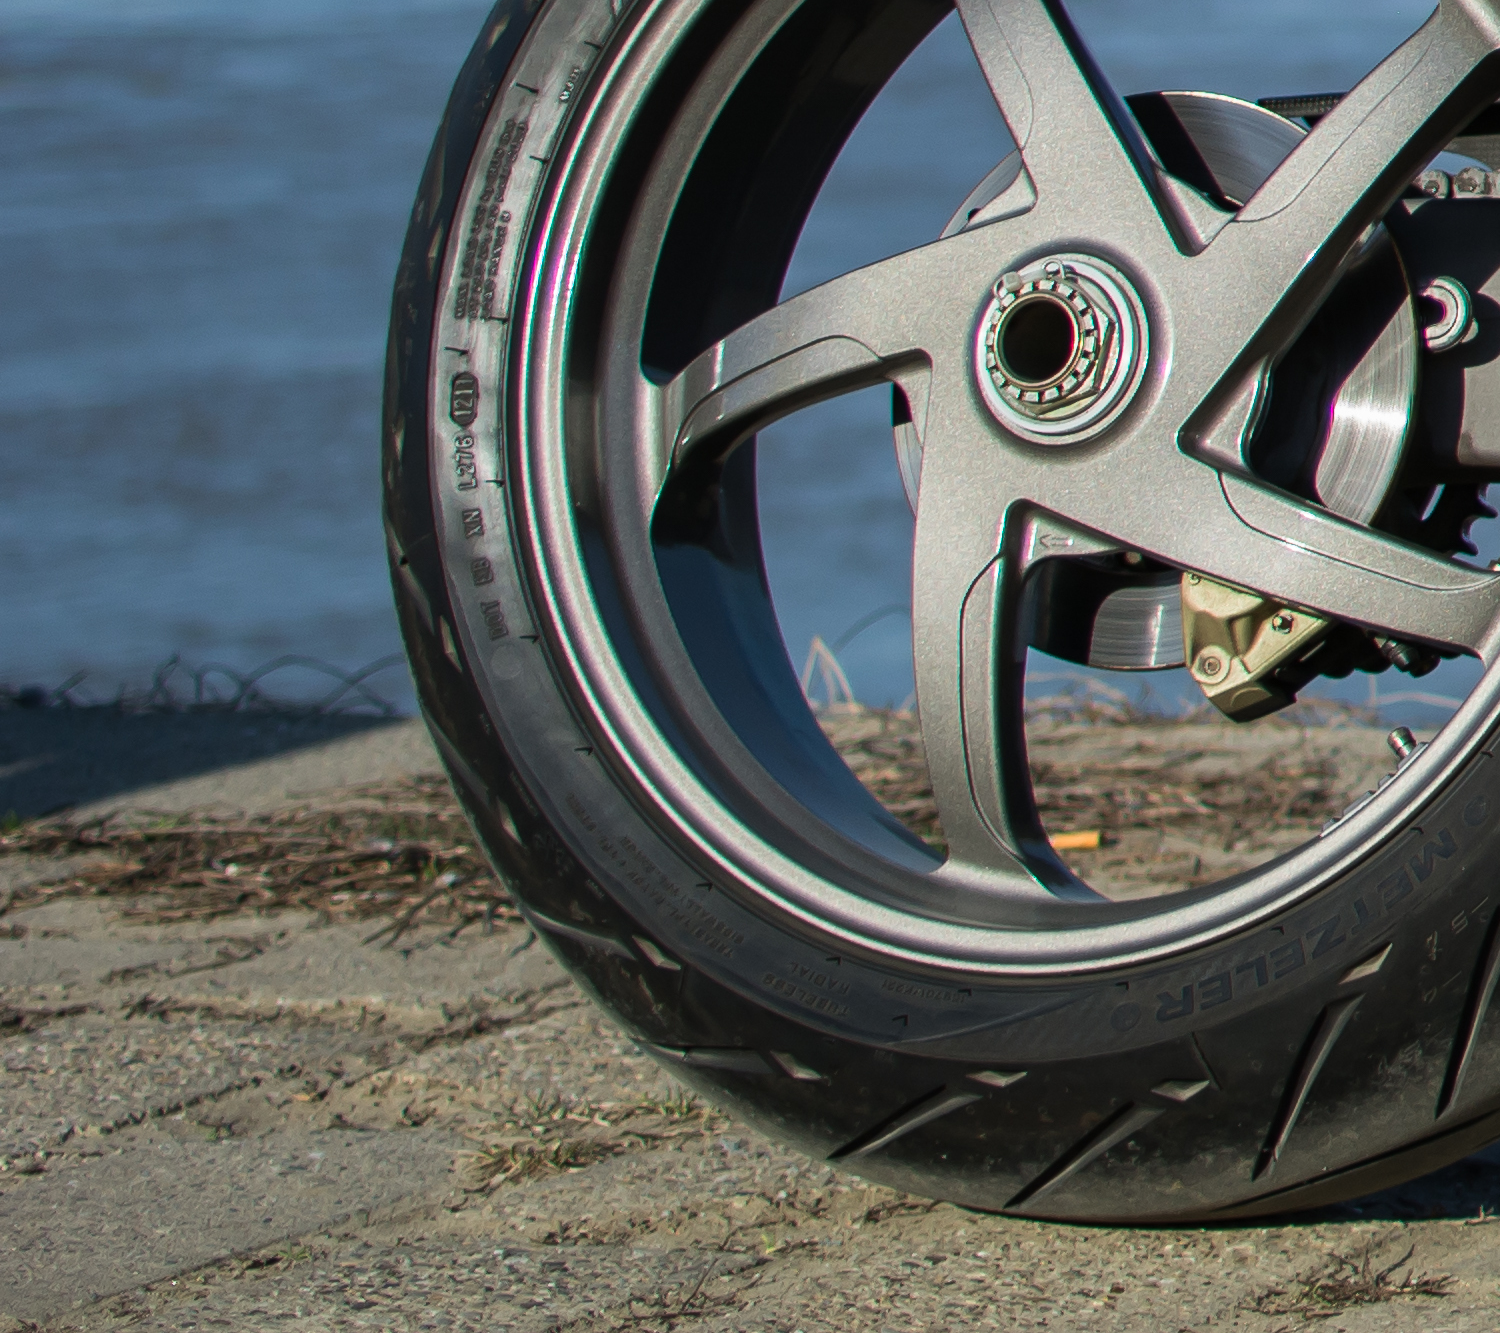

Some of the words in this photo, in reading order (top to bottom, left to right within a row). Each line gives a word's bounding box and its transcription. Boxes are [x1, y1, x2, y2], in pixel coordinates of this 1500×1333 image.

[451, 376, 477, 419] 1211
[454, 435, 479, 492] L276
[480, 597, 511, 642] DOT
[1151, 827, 1463, 1026] METZELER
